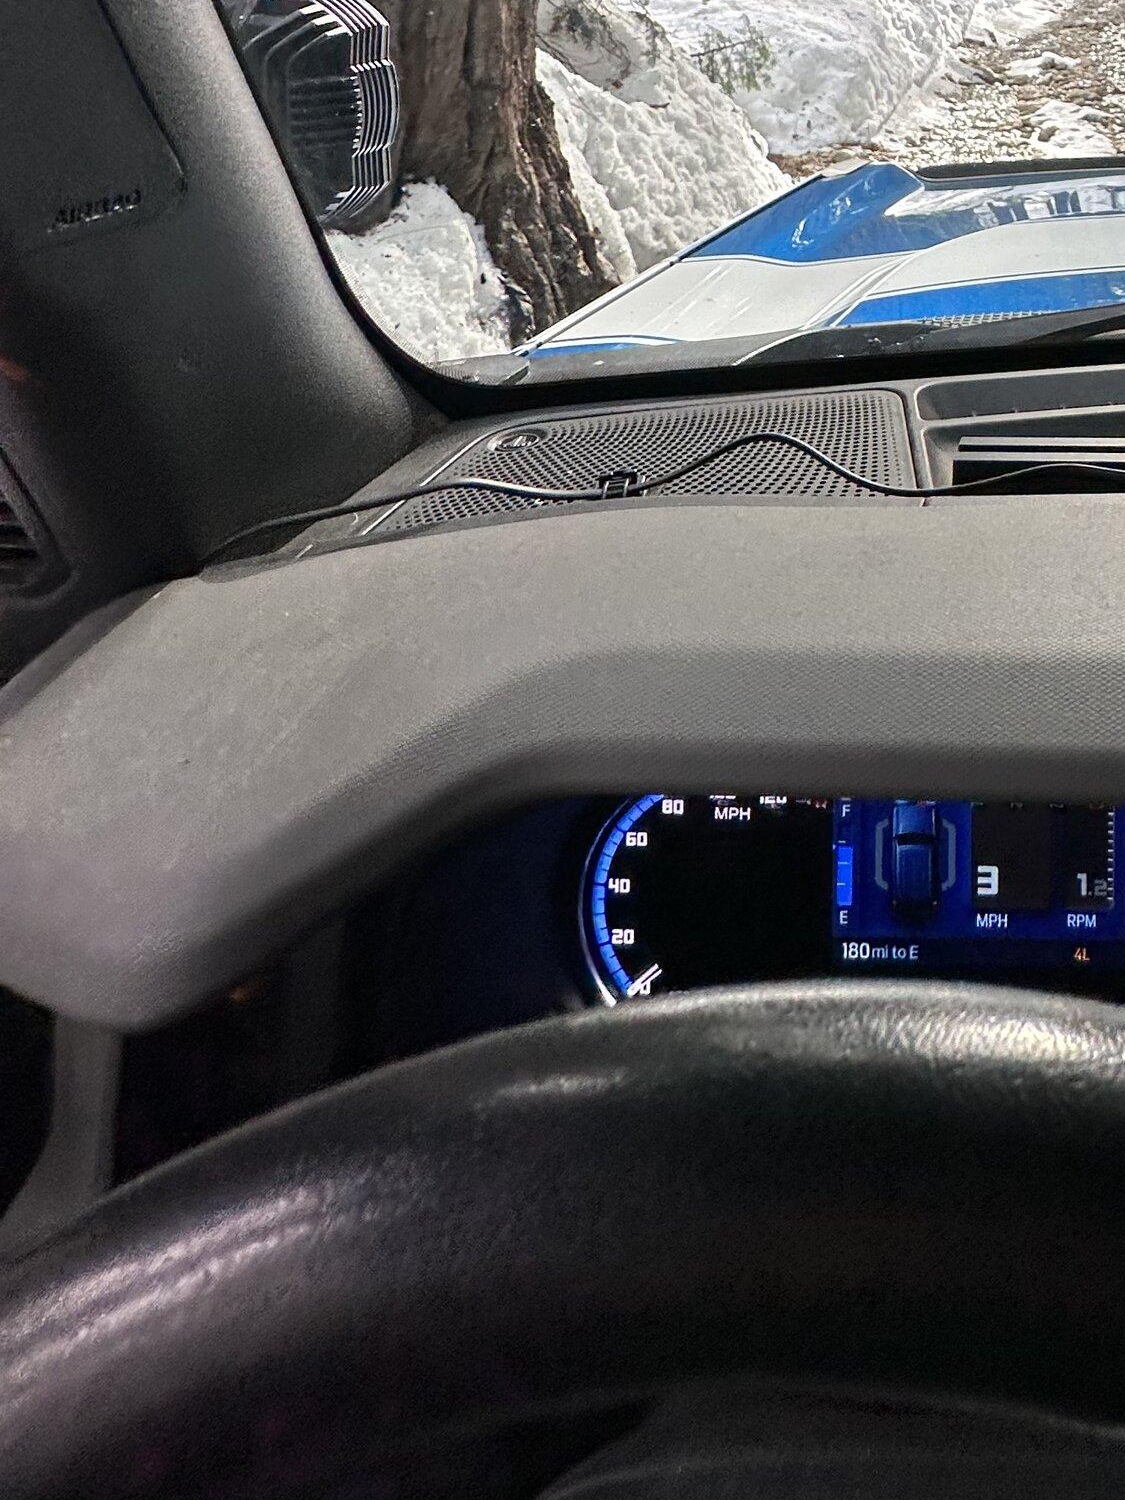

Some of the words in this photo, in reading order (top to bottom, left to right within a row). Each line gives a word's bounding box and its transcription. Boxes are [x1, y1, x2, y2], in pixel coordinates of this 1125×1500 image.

[662, 799, 684, 815] 80
[714, 806, 751, 821] MPH
[842, 804, 851, 818] F
[626, 832, 648, 847] 60
[608, 878, 631, 894] 40
[977, 865, 999, 897] 3
[839, 910, 849, 925] E
[976, 913, 1008, 928] MPH
[1067, 913, 1097, 928] RPM
[611, 928, 635, 945] 20
[892, 945, 907, 960] to
[909, 945, 919, 960] E
